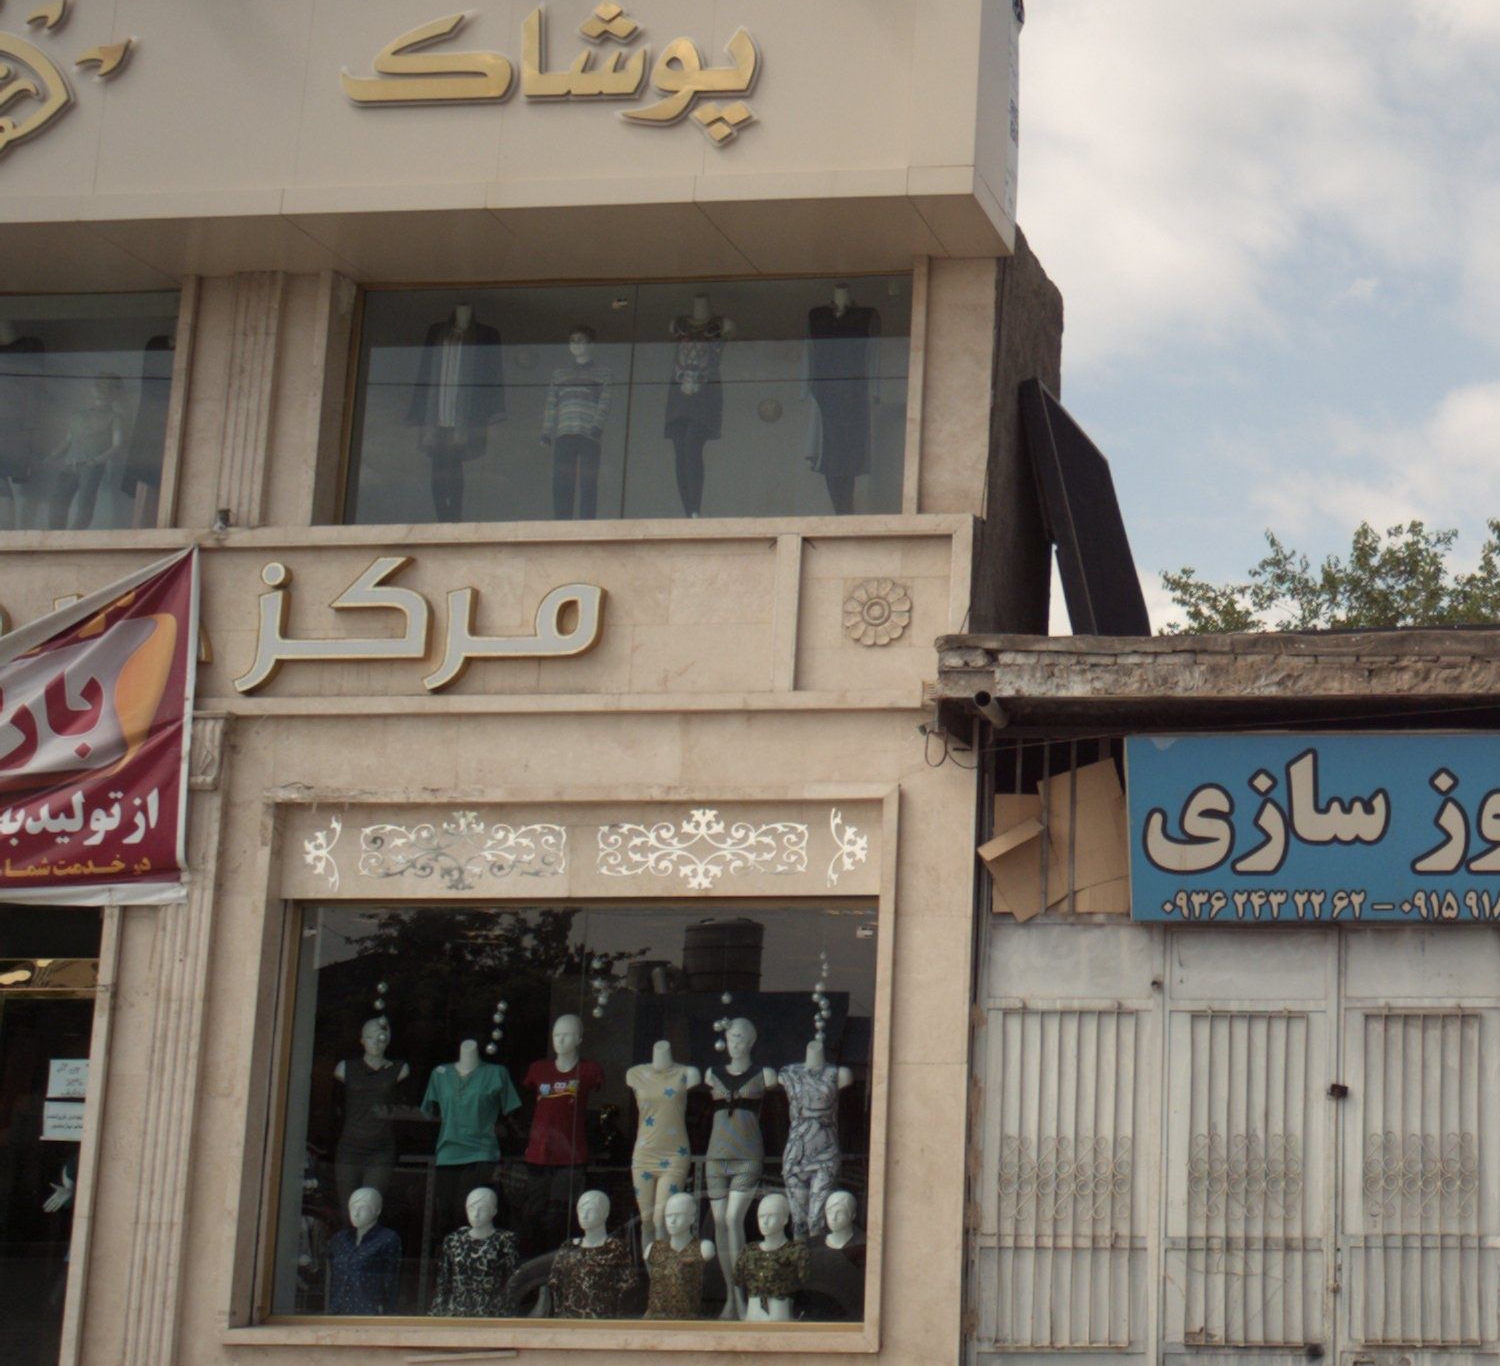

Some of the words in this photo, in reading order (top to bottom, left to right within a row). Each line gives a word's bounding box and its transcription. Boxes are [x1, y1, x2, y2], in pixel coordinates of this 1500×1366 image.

[232, 556, 608, 696] مرکز
[25, 790, 124, 846] تولید
[121, 787, 160, 844] از
[1143, 747, 1391, 875] سازی
[4, 856, 51, 878] شما
[53, 853, 126, 877] خدمت
[133, 856, 152, 875] در
[1161, 889, 1228, 920] ۰۹۳۶
[1232, 889, 1288, 920] ۲۴۳
[1293, 889, 1327, 920] ۲۲
[1331, 889, 1367, 920] ۶۲
[1399, 888, 1459, 920] ۰۹۱۵
